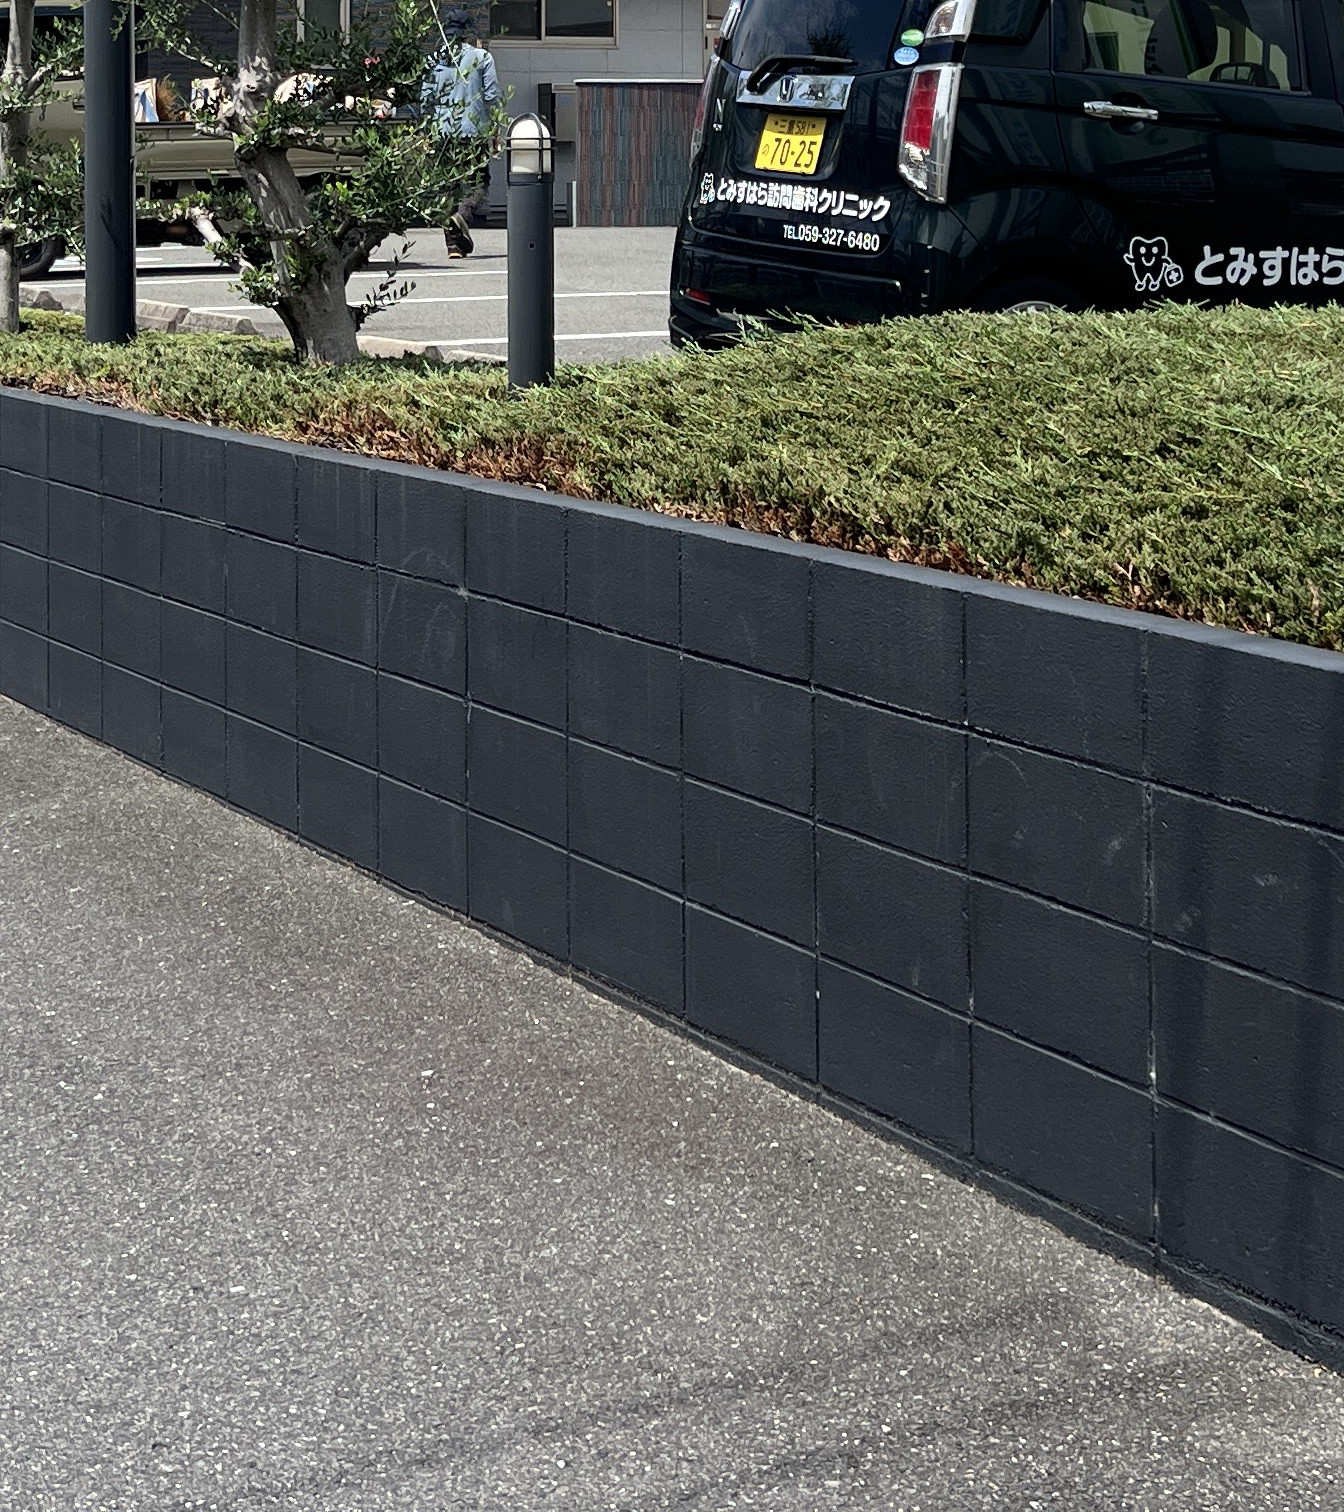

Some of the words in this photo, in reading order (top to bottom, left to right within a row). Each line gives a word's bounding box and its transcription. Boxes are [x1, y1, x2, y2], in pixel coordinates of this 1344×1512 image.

[716, 177, 891, 222] とみすはら訪問歯科クリニック
